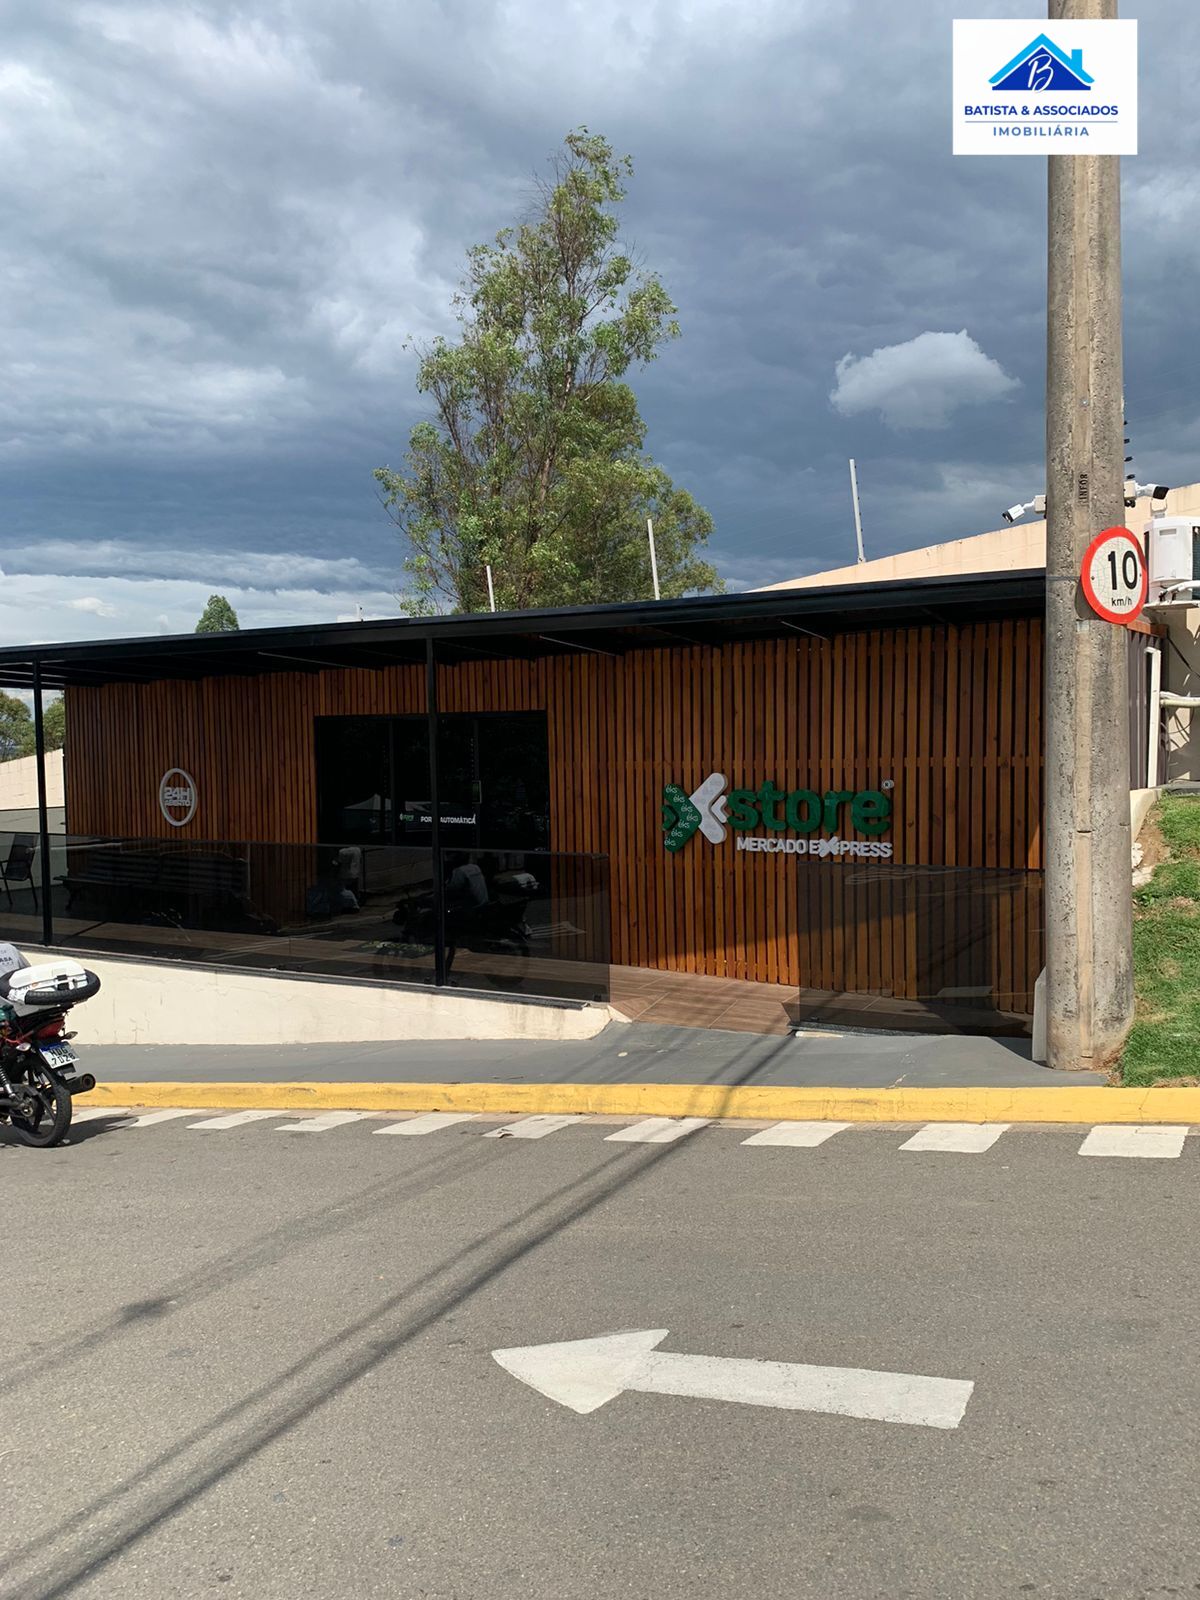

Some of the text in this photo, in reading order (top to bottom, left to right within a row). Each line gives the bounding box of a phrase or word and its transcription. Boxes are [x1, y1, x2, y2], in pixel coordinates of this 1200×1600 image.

[1107, 550, 1138, 591] 10
[1111, 597, 1133, 607] km/h
[736, 836, 893, 858] MERCADO EXPRESS
